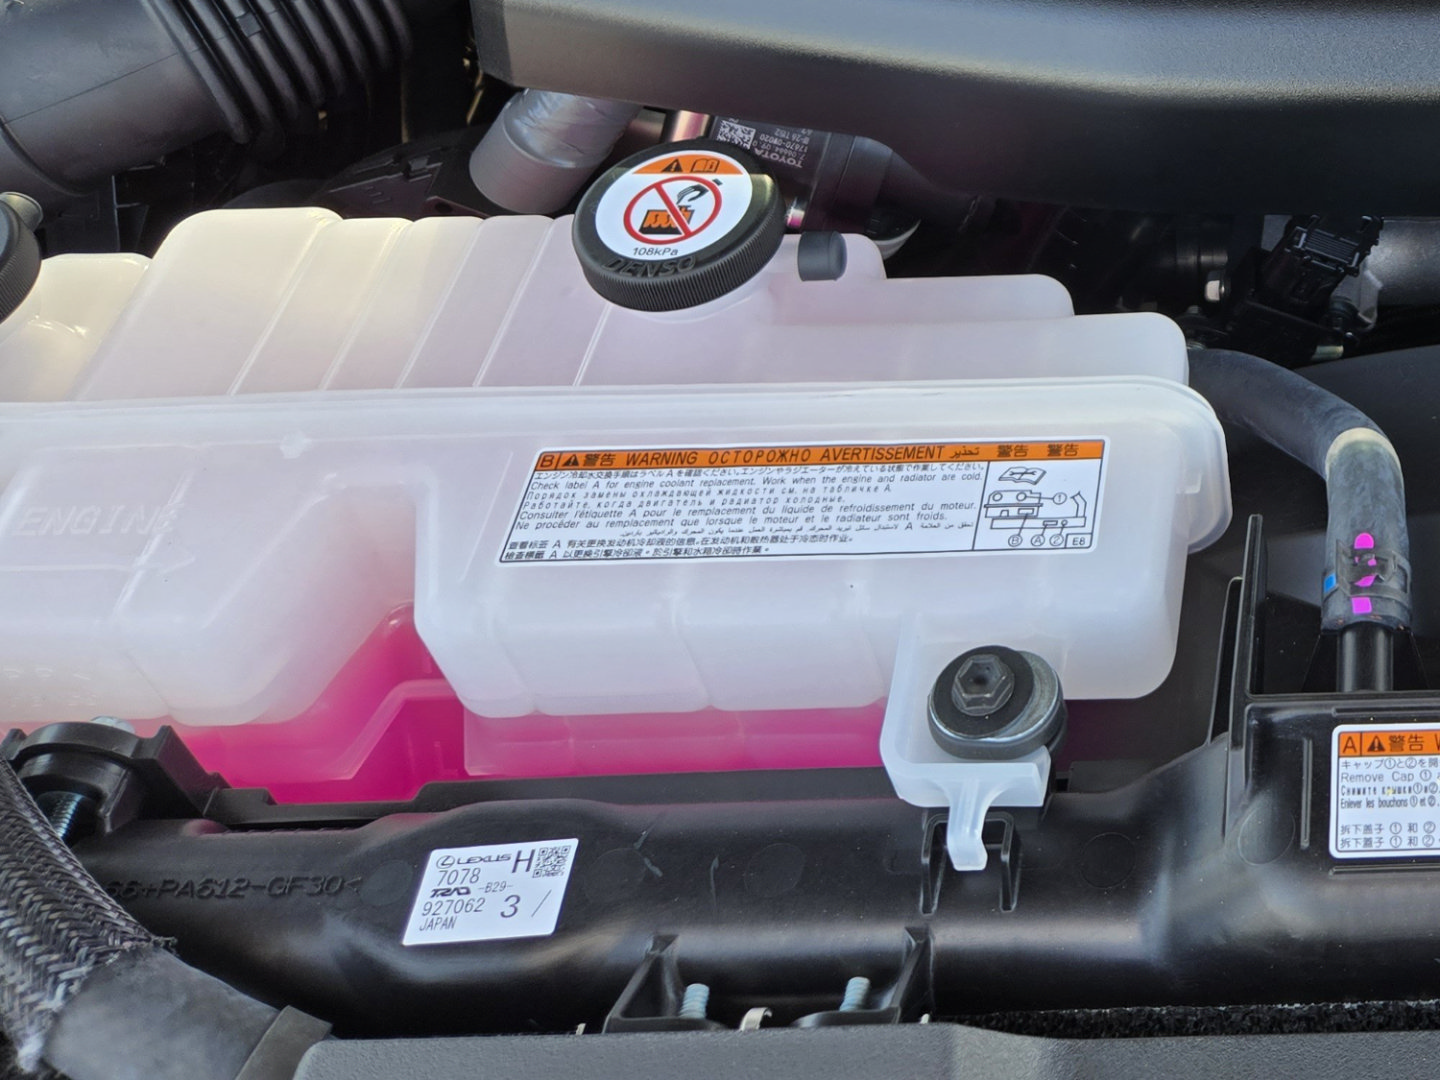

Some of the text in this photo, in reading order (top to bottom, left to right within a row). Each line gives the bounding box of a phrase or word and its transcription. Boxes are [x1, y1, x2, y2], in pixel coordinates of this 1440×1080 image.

[753, 147, 803, 169] TOYOTA
[632, 246, 678, 258] 108kPa
[601, 255, 697, 278] DENSO
[538, 454, 556, 467] B
[581, 452, 617, 466] 警告
[623, 451, 699, 465] WARNING
[706, 449, 812, 464] ОСТОРОЖНО
[819, 446, 945, 462] AVERTISSEMENT
[528, 472, 983, 490] Check label A for engine coolant replacement. Work when the engine and radiator are cold.
[12, 503, 186, 537] ENGINE
[514, 520, 530, 530] Ne
[584, 519, 600, 528] au
[604, 517, 675, 528] remplacement
[679, 518, 700, 527] que
[704, 516, 743, 526] lorsque
[747, 515, 758, 525] le
[763, 515, 799, 524] moteur
[803, 514, 815, 524] et
[820, 514, 830, 523] le
[834, 513, 882, 523] radiateur
[887, 512, 910, 522] sont
[915, 511, 947, 521] froids.
[518, 509, 569, 519] Consulter
[627, 508, 638, 517] A
[641, 509, 666, 518] pour
[671, 507, 683, 516] le
[686, 506, 757, 517] remplacement
[761, 505, 776, 514] du
[780, 504, 815, 515] liquide
[819, 504, 834, 513] de
[838, 502, 915, 513] refroidissement
[920, 502, 934, 511] du
[939, 502, 976, 510] moteur.
[1342, 735, 1357, 753] A
[1388, 733, 1425, 752] 警告
[1340, 770, 1384, 783] Remove
[1391, 770, 1414, 783] Cap
[1340, 797, 1362, 809] Enlever
[1365, 797, 1374, 808] les
[1377, 796, 1408, 808] bouchons
[1419, 796, 1426, 807] et
[456, 848, 537, 874] LEXUS H
[437, 867, 482, 887] 7078
[421, 894, 521, 919] 927062 3
[418, 916, 458, 932] JAPAN
